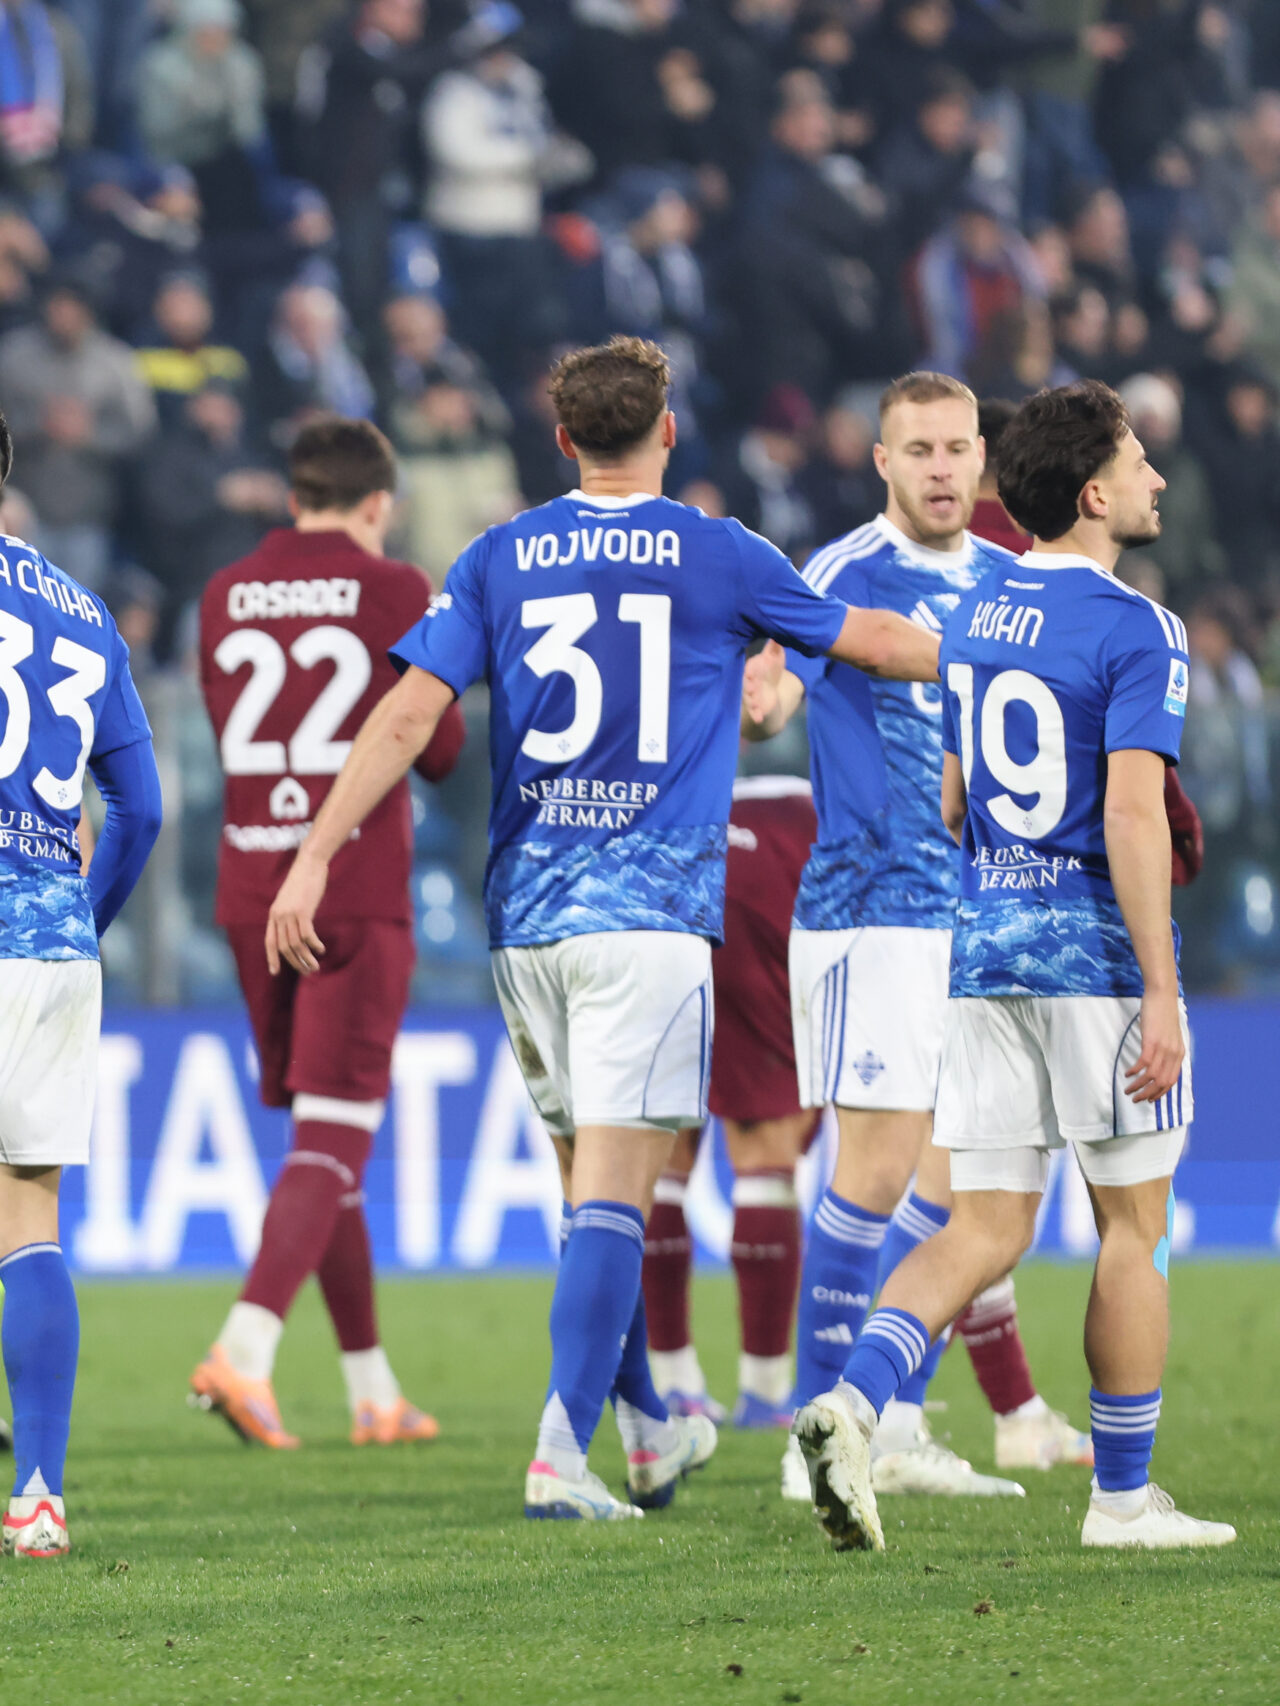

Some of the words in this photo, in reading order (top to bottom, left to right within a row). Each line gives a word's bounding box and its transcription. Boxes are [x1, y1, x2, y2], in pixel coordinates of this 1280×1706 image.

[227, 577, 361, 622] CASADEI
[515, 527, 681, 572] VOJVODA
[214, 624, 373, 776] 22
[521, 592, 672, 763] 31
[947, 662, 1068, 840] 19
